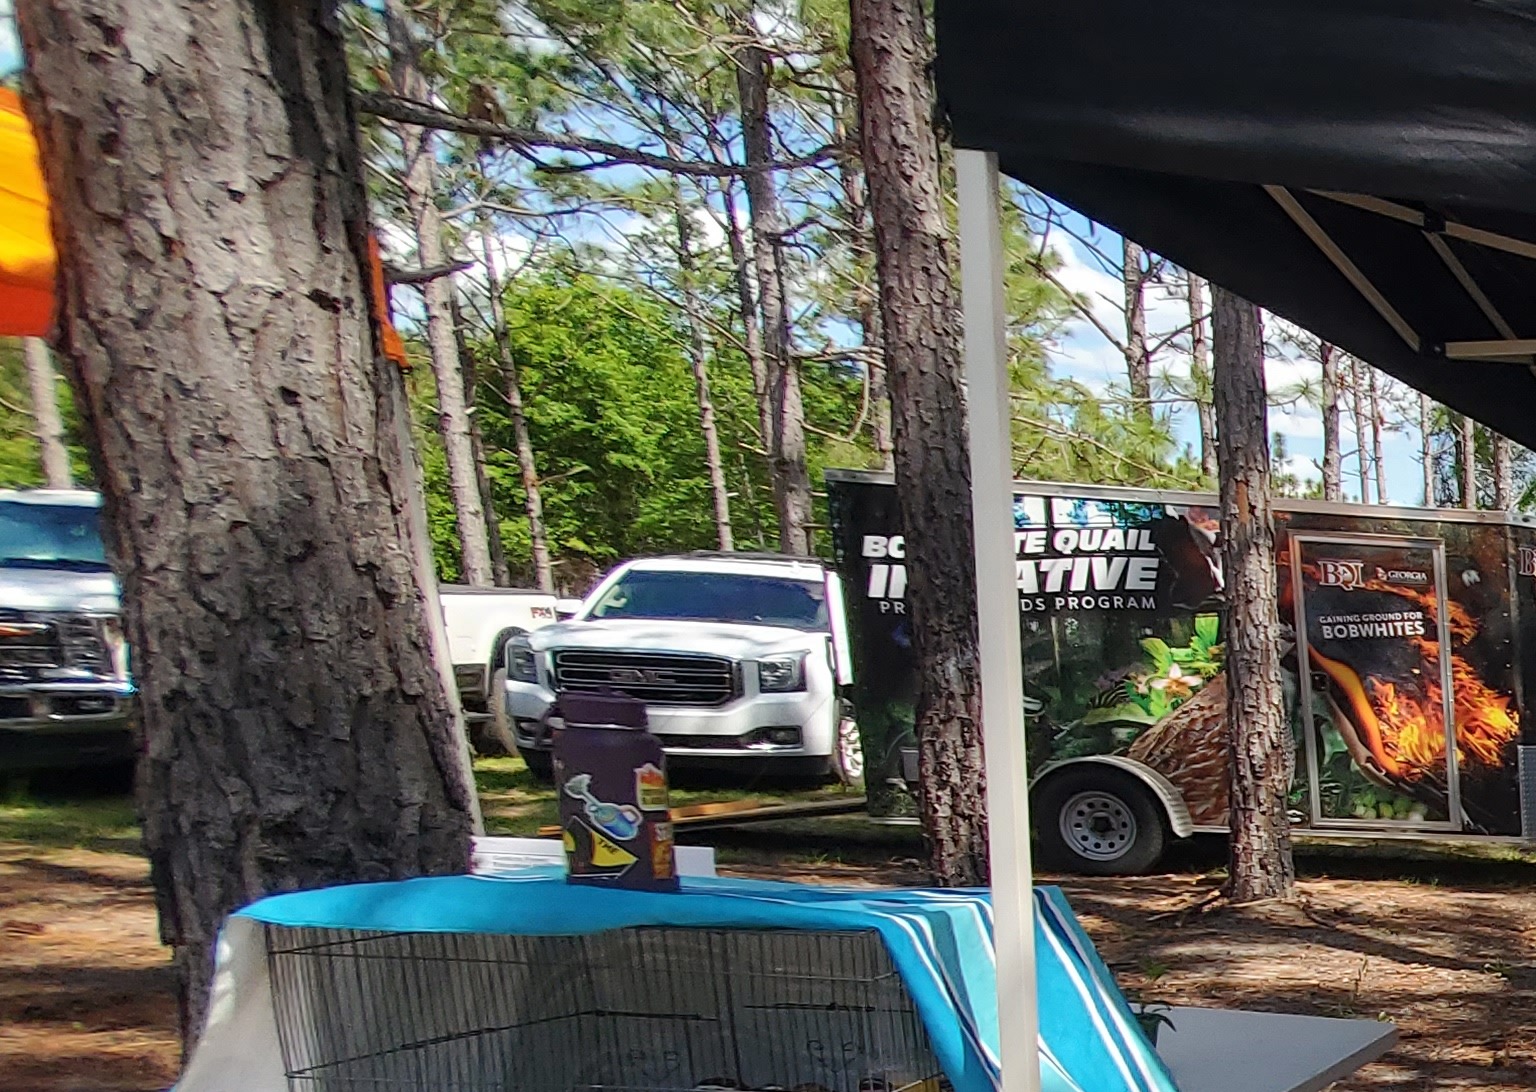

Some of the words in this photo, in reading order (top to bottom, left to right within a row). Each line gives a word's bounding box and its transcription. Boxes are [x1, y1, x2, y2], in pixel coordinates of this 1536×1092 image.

[1053, 529, 1155, 554] QUAIL
[1055, 596, 1156, 610] PROGRAM
[1320, 614, 1360, 624] GAINING
[1362, 612, 1401, 622] GROUND
[1402, 611, 1423, 620] FOR
[1322, 621, 1425, 639] BOBWHITES
